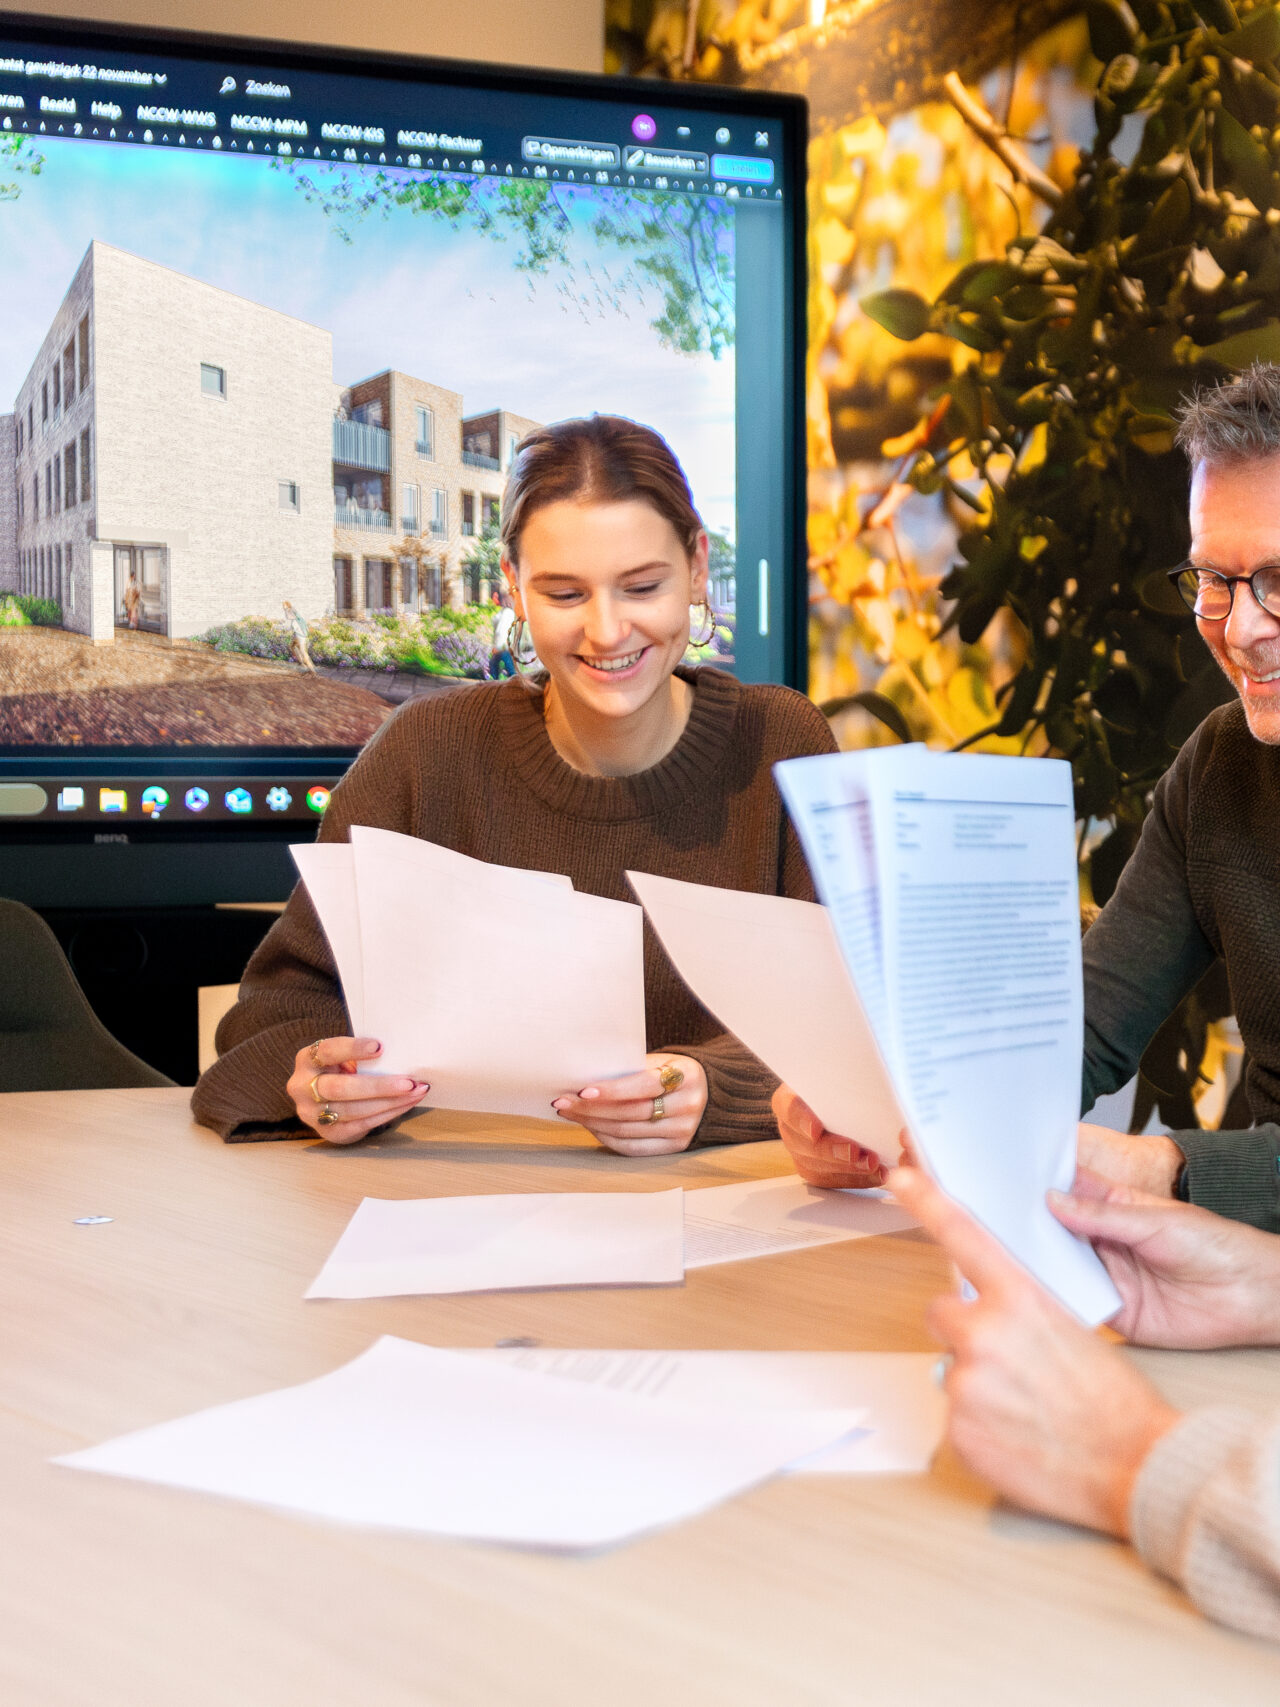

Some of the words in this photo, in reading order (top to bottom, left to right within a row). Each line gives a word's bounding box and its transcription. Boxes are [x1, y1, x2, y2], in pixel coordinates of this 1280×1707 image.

[82, 65, 97, 79] 22
[98, 68, 153, 85] november
[245, 79, 291, 97] Zoeken
[40, 96, 77, 113] Beeld
[91, 101, 122, 120] Help
[541, 143, 615, 165] Opmerkingen
[644, 153, 696, 171] Bewerken
